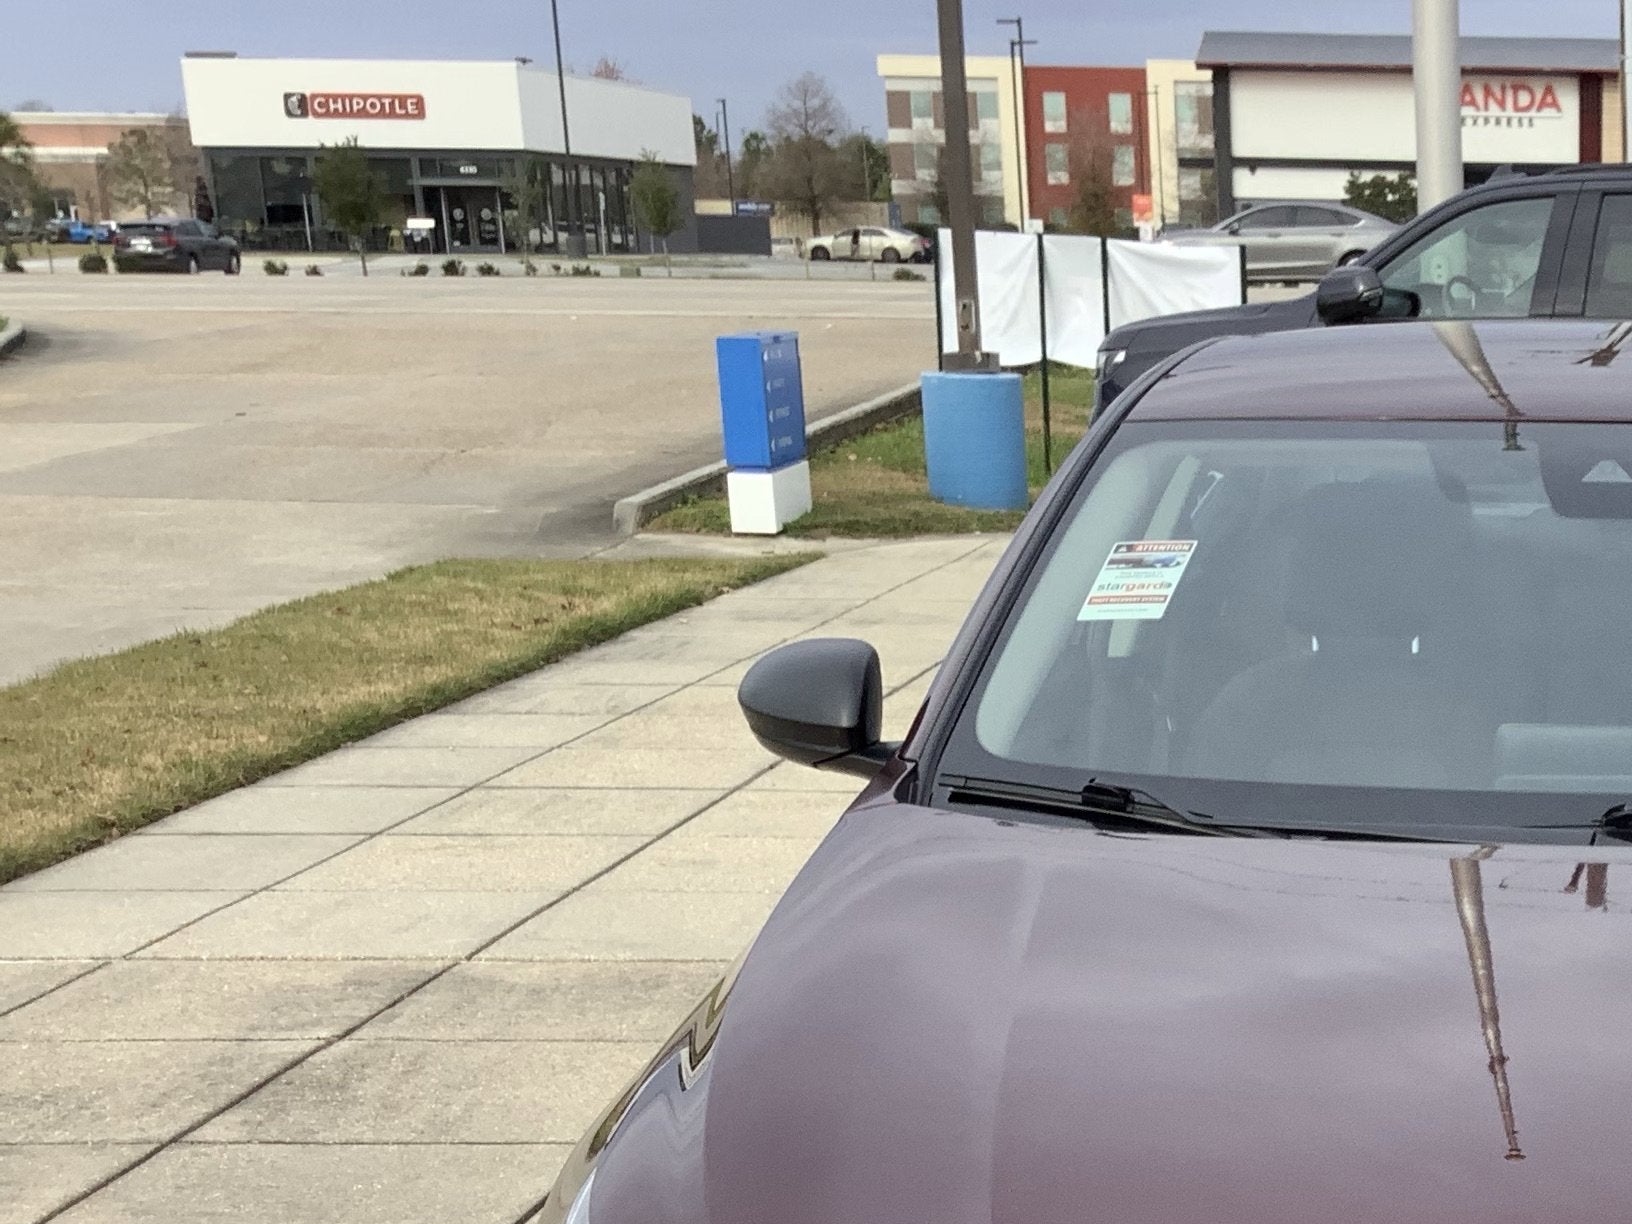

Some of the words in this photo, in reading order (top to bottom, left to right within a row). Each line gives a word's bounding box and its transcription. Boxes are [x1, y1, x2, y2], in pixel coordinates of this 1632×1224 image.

[313, 96, 419, 114] CHIPOTLE
[1459, 82, 1562, 113] ANDA
[1135, 543, 1191, 552] ATTENTION
